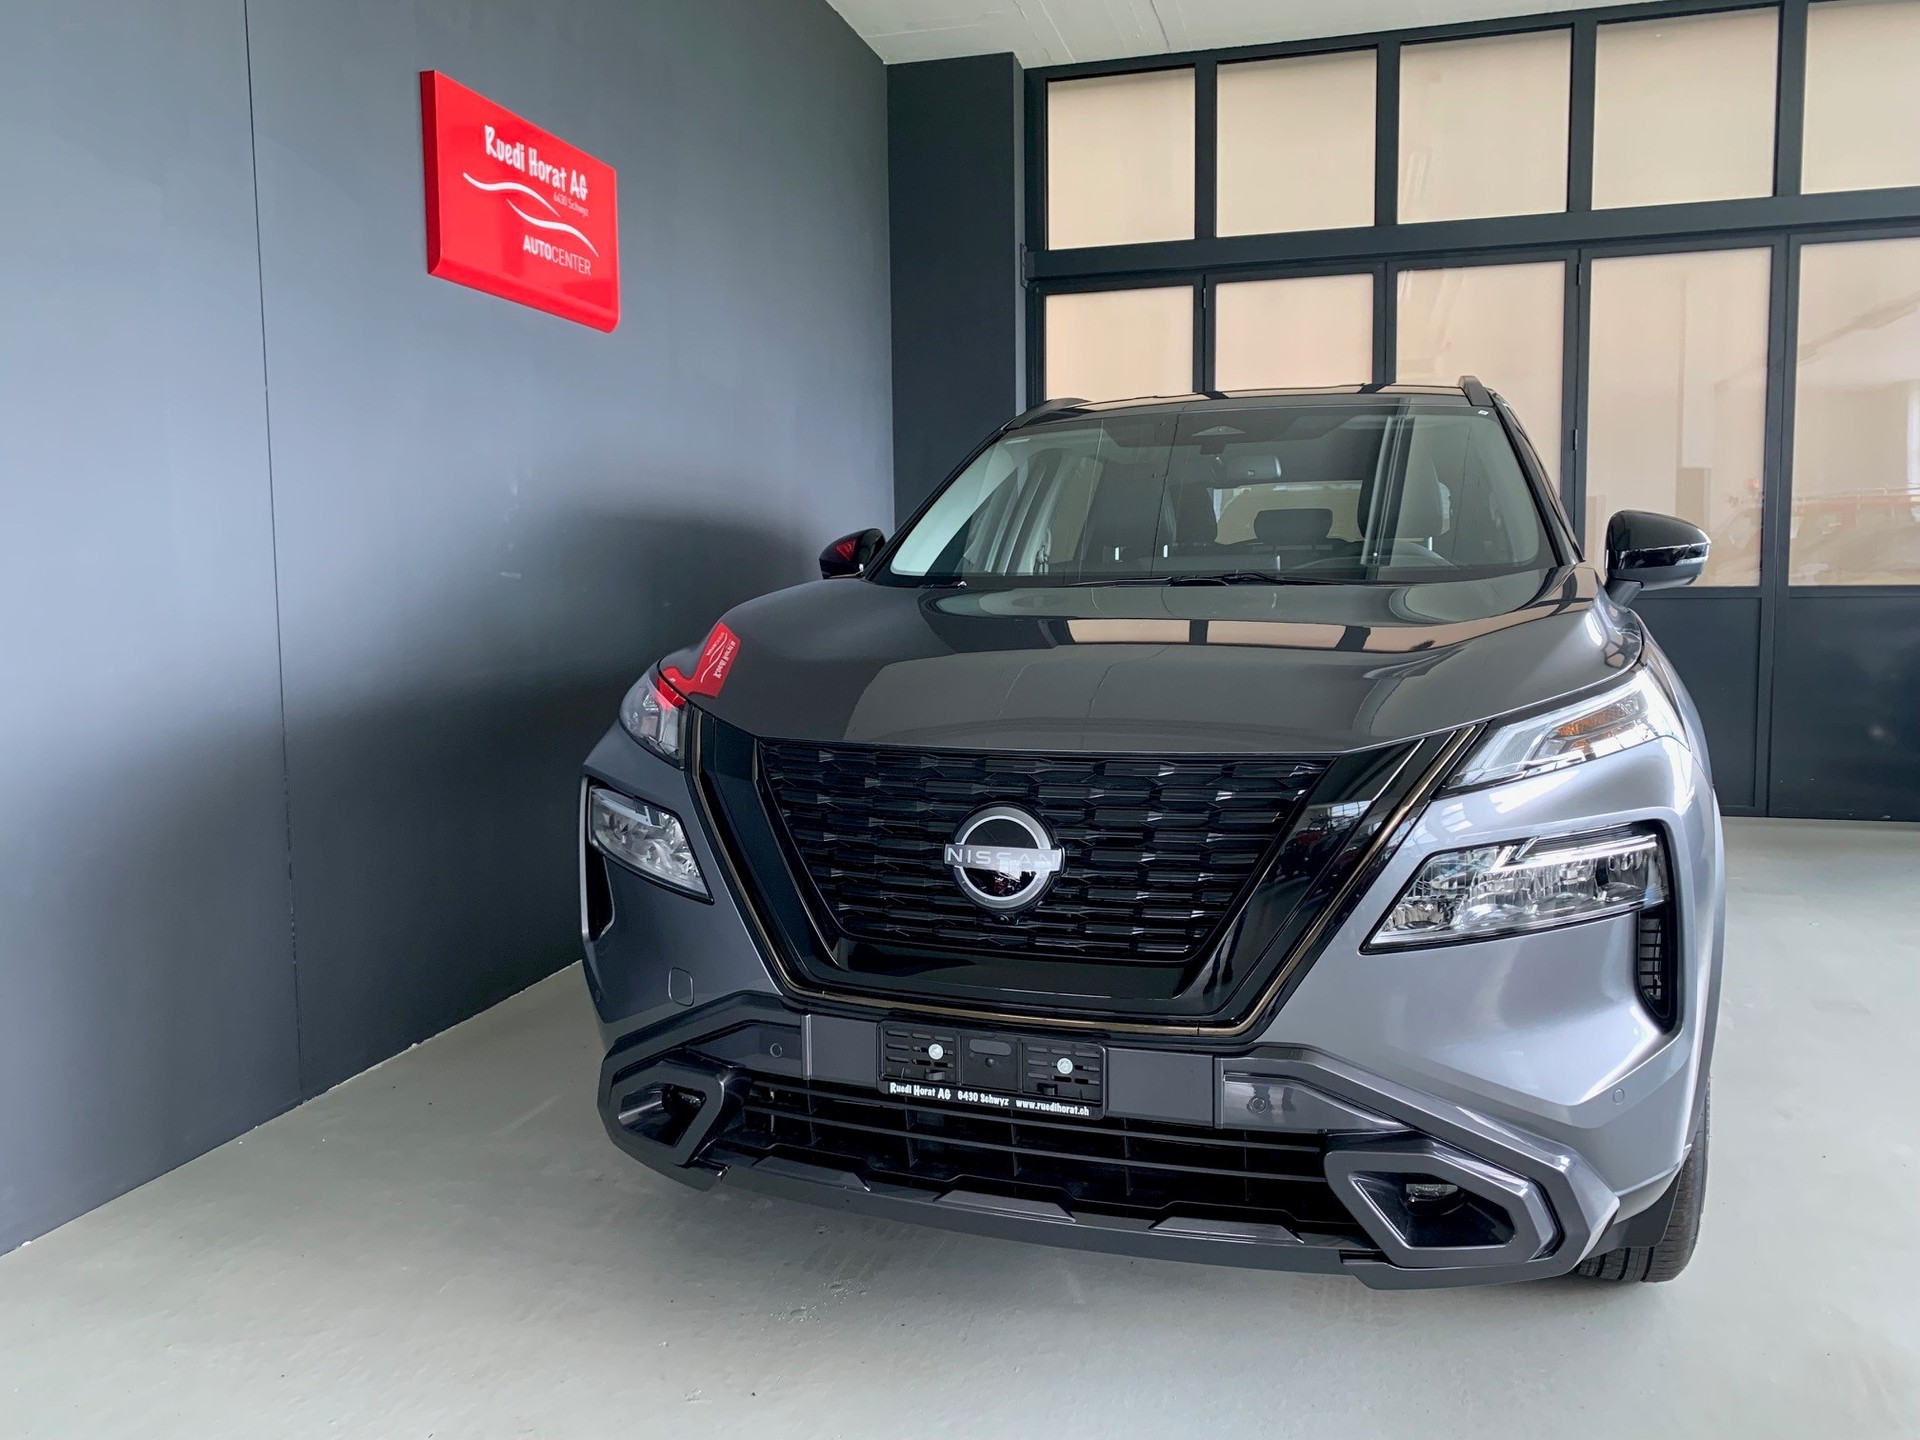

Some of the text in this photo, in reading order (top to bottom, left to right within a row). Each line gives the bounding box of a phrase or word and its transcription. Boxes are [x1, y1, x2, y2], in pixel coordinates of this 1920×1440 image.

[484, 125, 588, 201] Ruedi Horat AG
[523, 234, 591, 276] AUTOCENTER
[947, 847, 1056, 867] NISSAN
[890, 1082, 1089, 1116] Ruedi Horat AG 6430 Schwyz www.ruedihorat.ch
